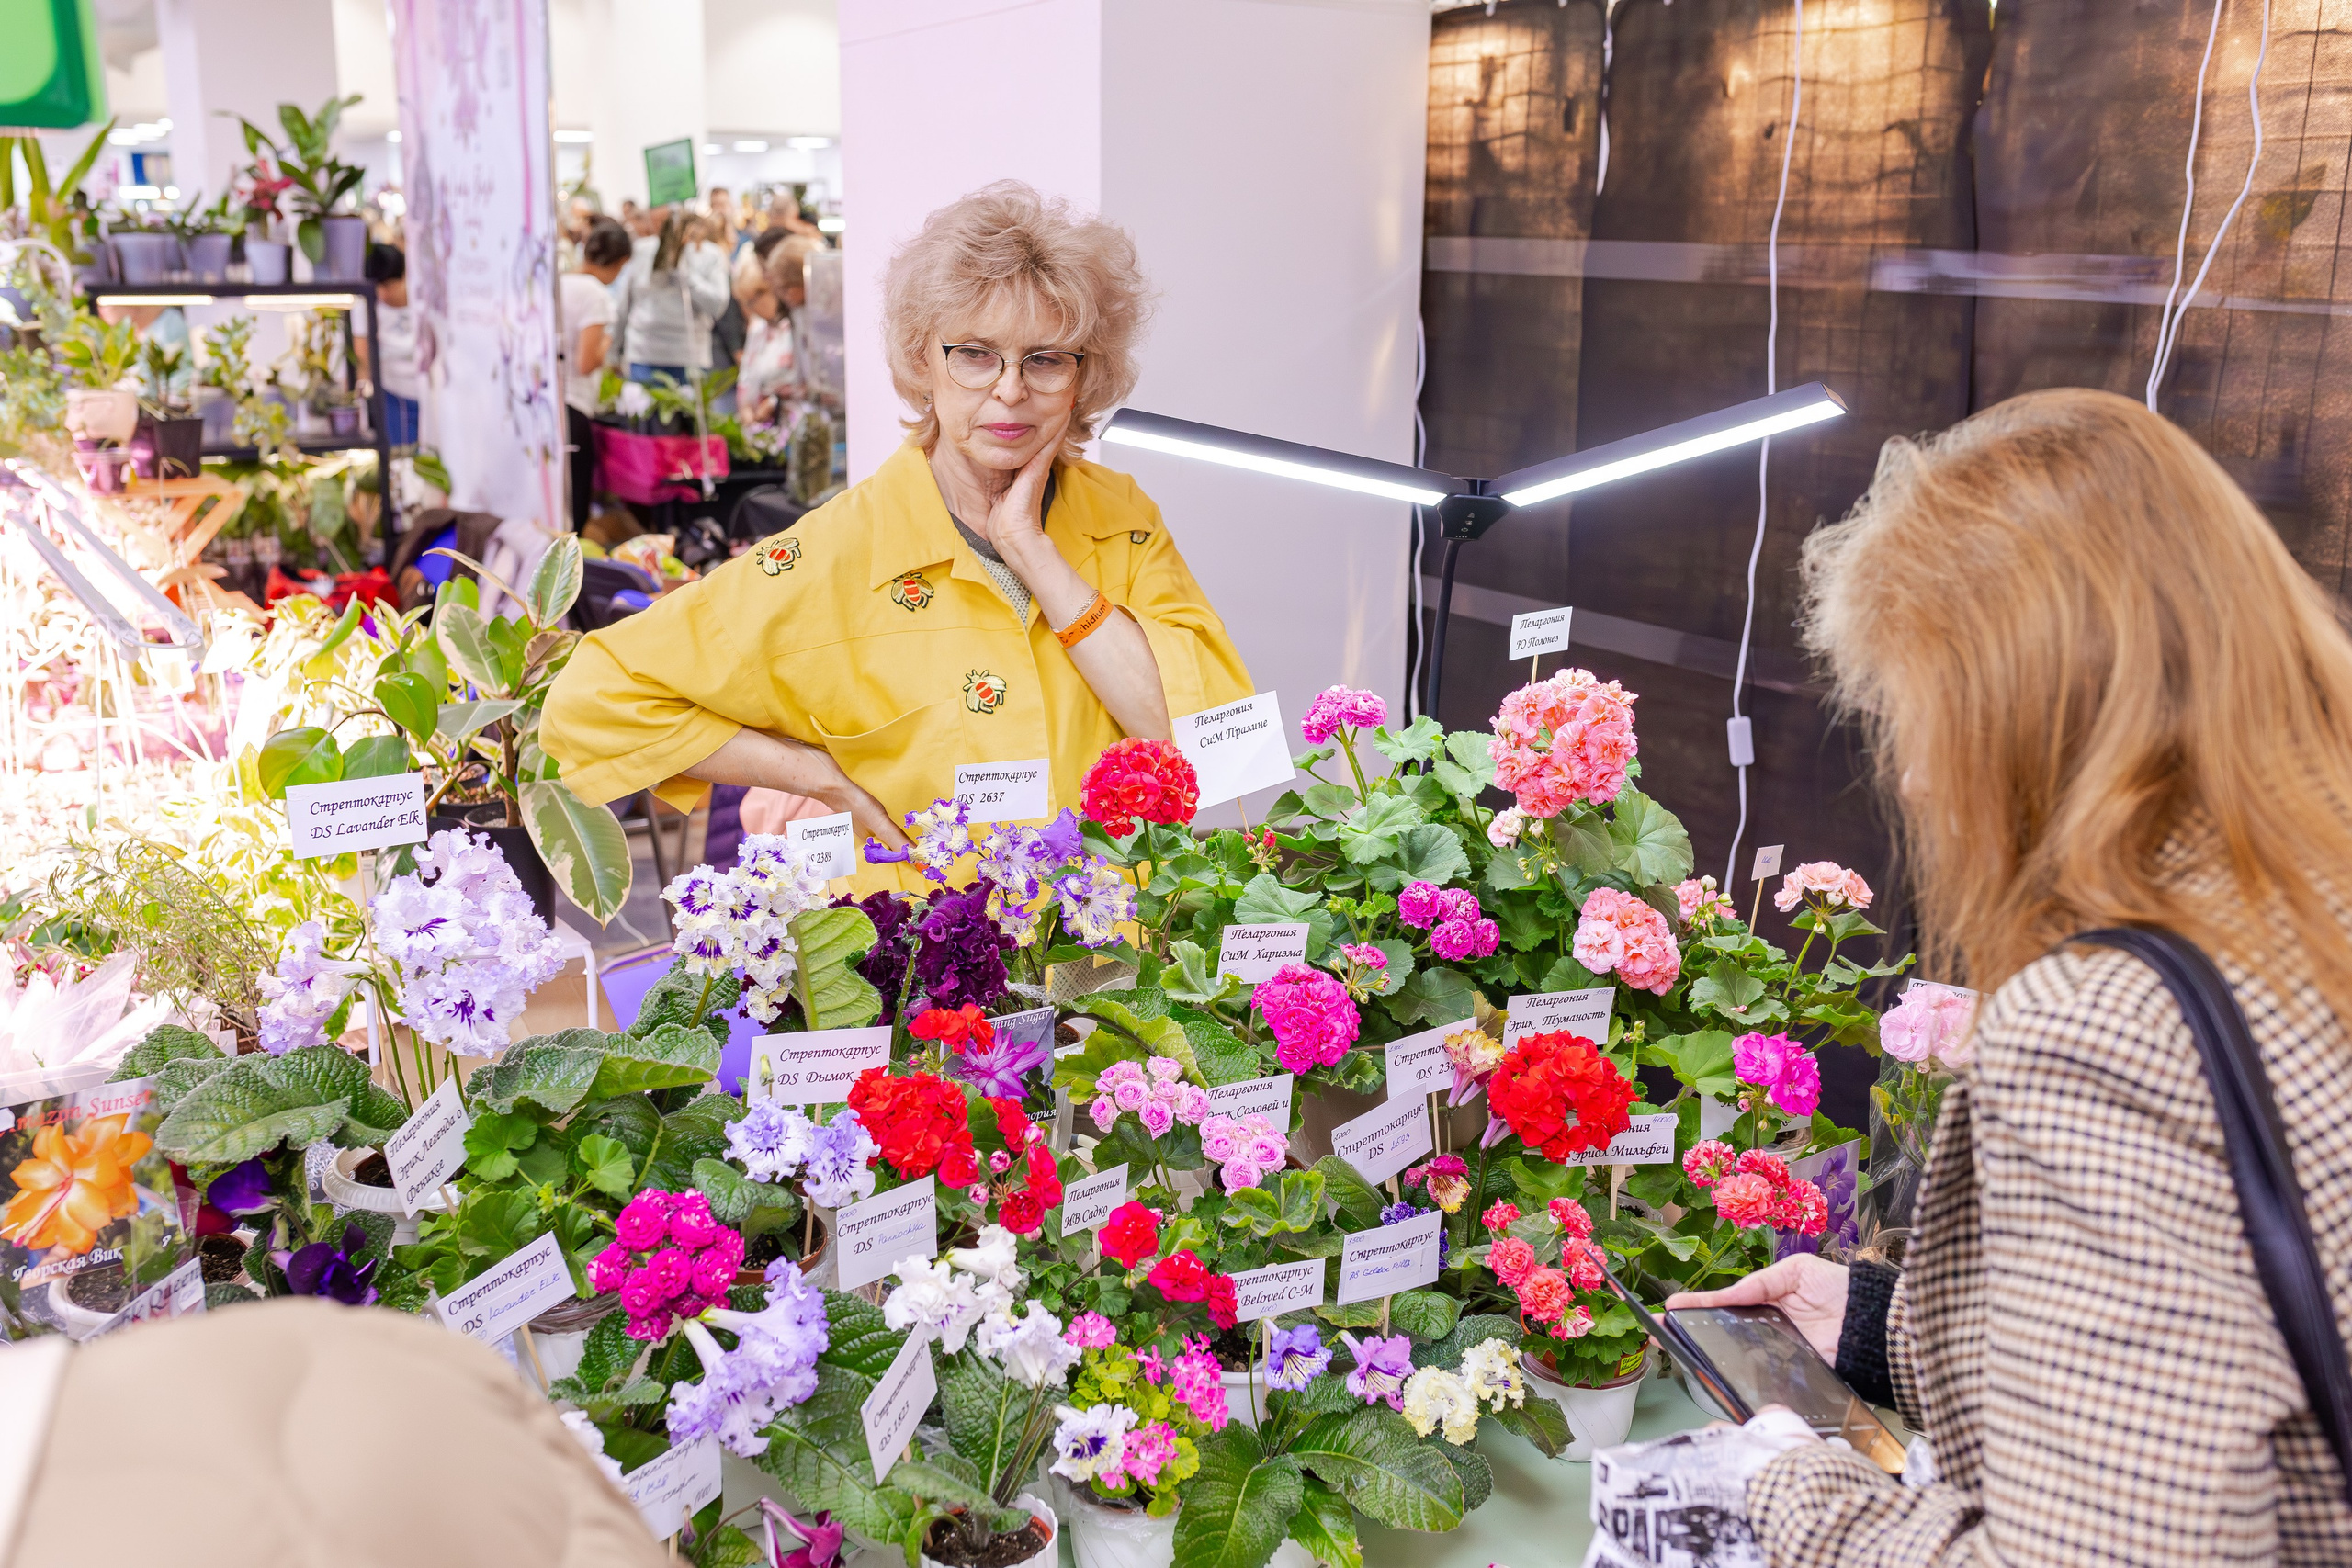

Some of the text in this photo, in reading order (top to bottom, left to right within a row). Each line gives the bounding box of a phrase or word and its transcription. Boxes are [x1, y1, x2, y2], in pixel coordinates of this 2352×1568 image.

[1520, 615, 1565, 629] Пеларгония
[1516, 636, 1559, 650] Ю Полонез
[1194, 702, 1253, 728] Пеларгония
[1199, 719, 1268, 749] СиМ Пралине
[958, 771, 1038, 785] Стрептокарпус
[310, 791, 413, 816] Стрептокарпус
[957, 792, 1005, 805] DS 2637
[310, 810, 424, 839] DS Lavander Elk
[801, 823, 850, 841] Стрептокарпус
[817, 851, 832, 863] 2389
[1230, 928, 1297, 942] Пеларгония
[1220, 947, 1303, 962] СиМ Харизма
[1526, 993, 1589, 1009] Пеларгония
[1018, 1010, 1051, 1026] Sugar
[1508, 1010, 1606, 1032] Эрик Туманость
[780, 1045, 882, 1063] Стрептокарпус
[1394, 1044, 1449, 1066] Стрепток
[777, 1070, 856, 1085] DS Дымок
[1416, 1066, 1433, 1080] DS
[1207, 1081, 1273, 1101] Пеларгония
[0, 1089, 153, 1138] mazon Sunset
[1237, 1100, 1280, 1118] Соловей
[1282, 1100, 1289, 1109] и
[389, 1099, 442, 1158] Пеларгония
[1337, 1103, 1425, 1158] Стрептокарпус
[397, 1109, 462, 1182] Эрик Легенда о
[1368, 1143, 1385, 1160] DS
[1611, 1142, 1669, 1159] Мильфёй
[406, 1158, 445, 1205] Фениксе
[1067, 1178, 1120, 1203] Пеларгония
[838, 1193, 933, 1237] Стрептокарпус
[1082, 1204, 1108, 1223] Садко
[853, 1237, 874, 1255] DS
[1349, 1231, 1434, 1262] Стрептокарпус
[447, 1246, 552, 1316] Стрептокарпус
[1240, 1282, 1315, 1307] Beloved C-M
[461, 1313, 483, 1335] DS
[878, 1428, 893, 1452] DS
